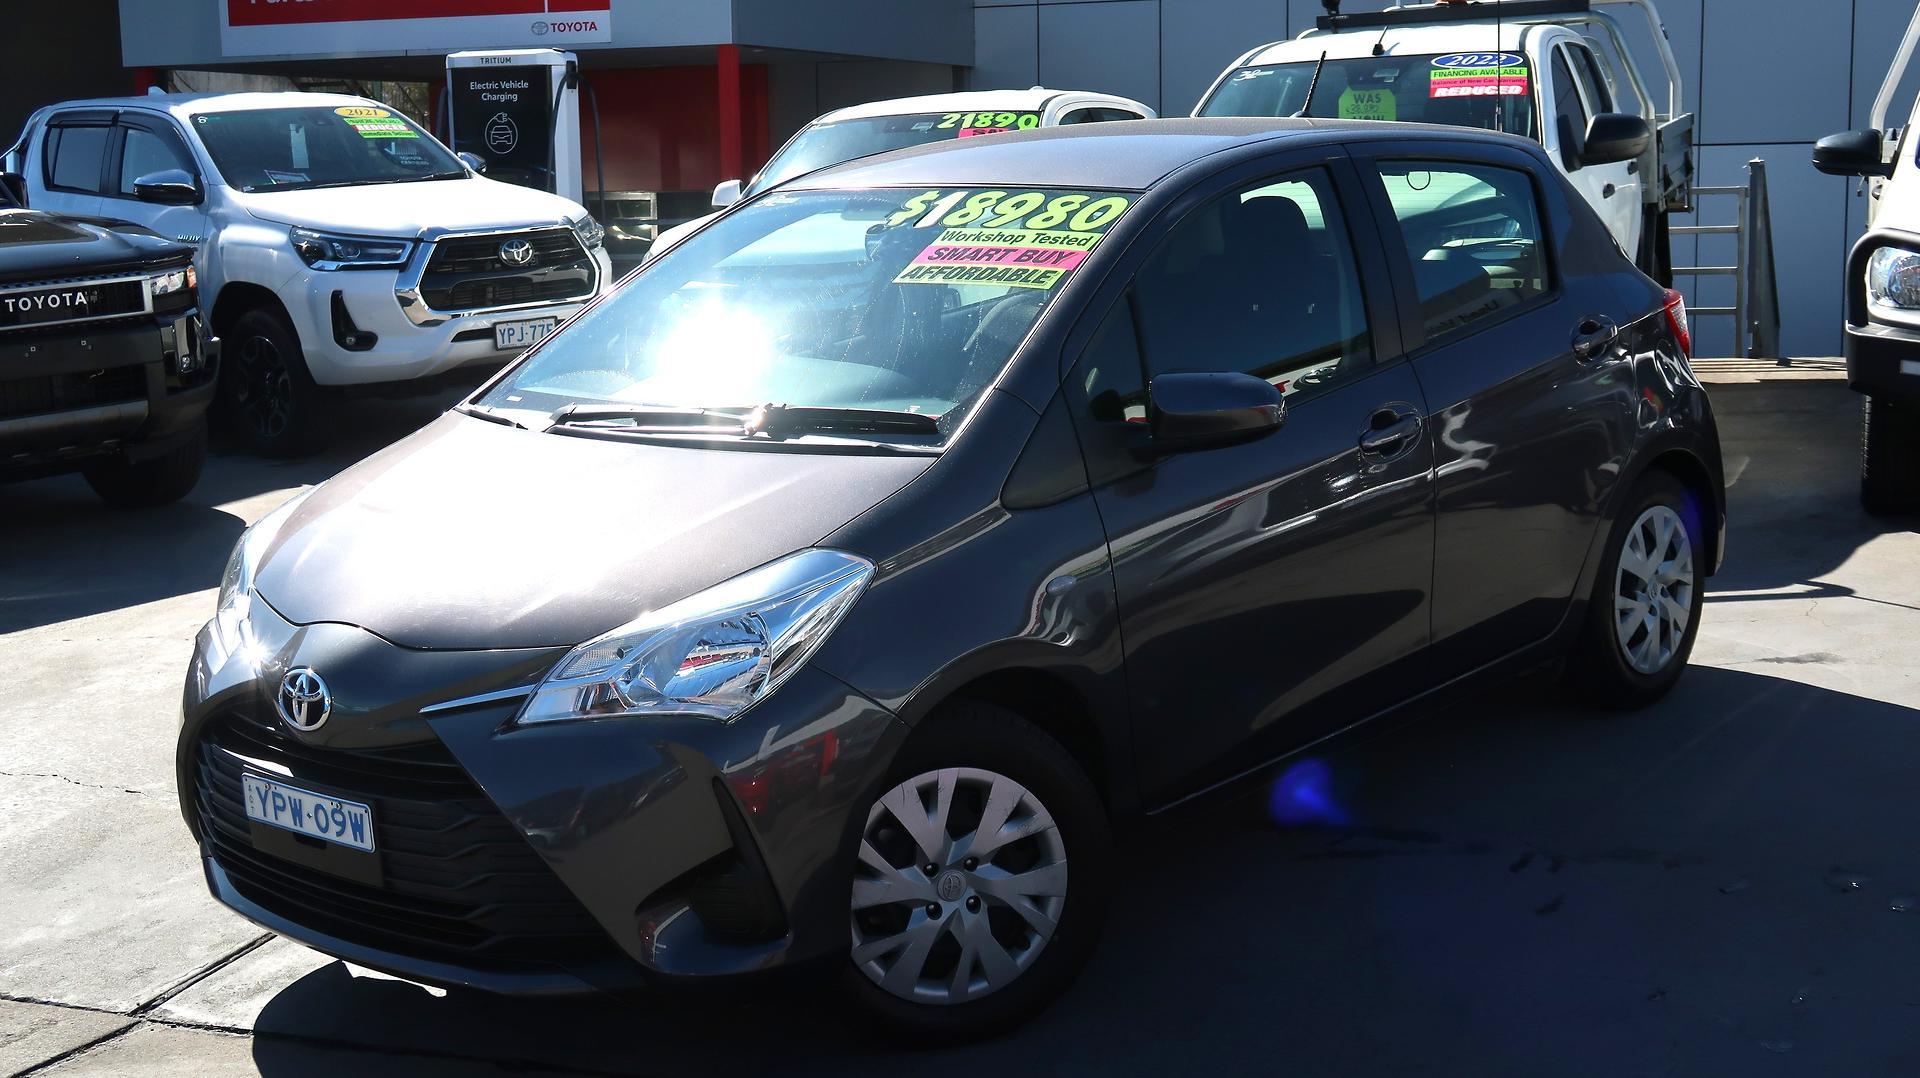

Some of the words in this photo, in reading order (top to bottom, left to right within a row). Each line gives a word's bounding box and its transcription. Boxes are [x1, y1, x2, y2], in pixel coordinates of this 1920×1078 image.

[551, 21, 598, 33] TOYOTA
[1445, 54, 1508, 66] 2022
[1433, 70, 1477, 78] FINANCING
[470, 81, 499, 90] Electric
[500, 80, 529, 89] Vehicle
[481, 92, 518, 102] Charging
[1434, 86, 1523, 97] REDUCED
[1353, 93, 1382, 103] WAS
[345, 108, 379, 116] 2021
[937, 111, 1039, 131] 21890
[885, 191, 1128, 231] $18980
[940, 231, 1026, 245] Workshop
[1030, 232, 1093, 247] Tested
[927, 247, 1017, 262] SMART
[1013, 249, 1076, 265] BUY
[900, 265, 1058, 285] AFFORDABLE
[4, 291, 88, 313] TOYOTA
